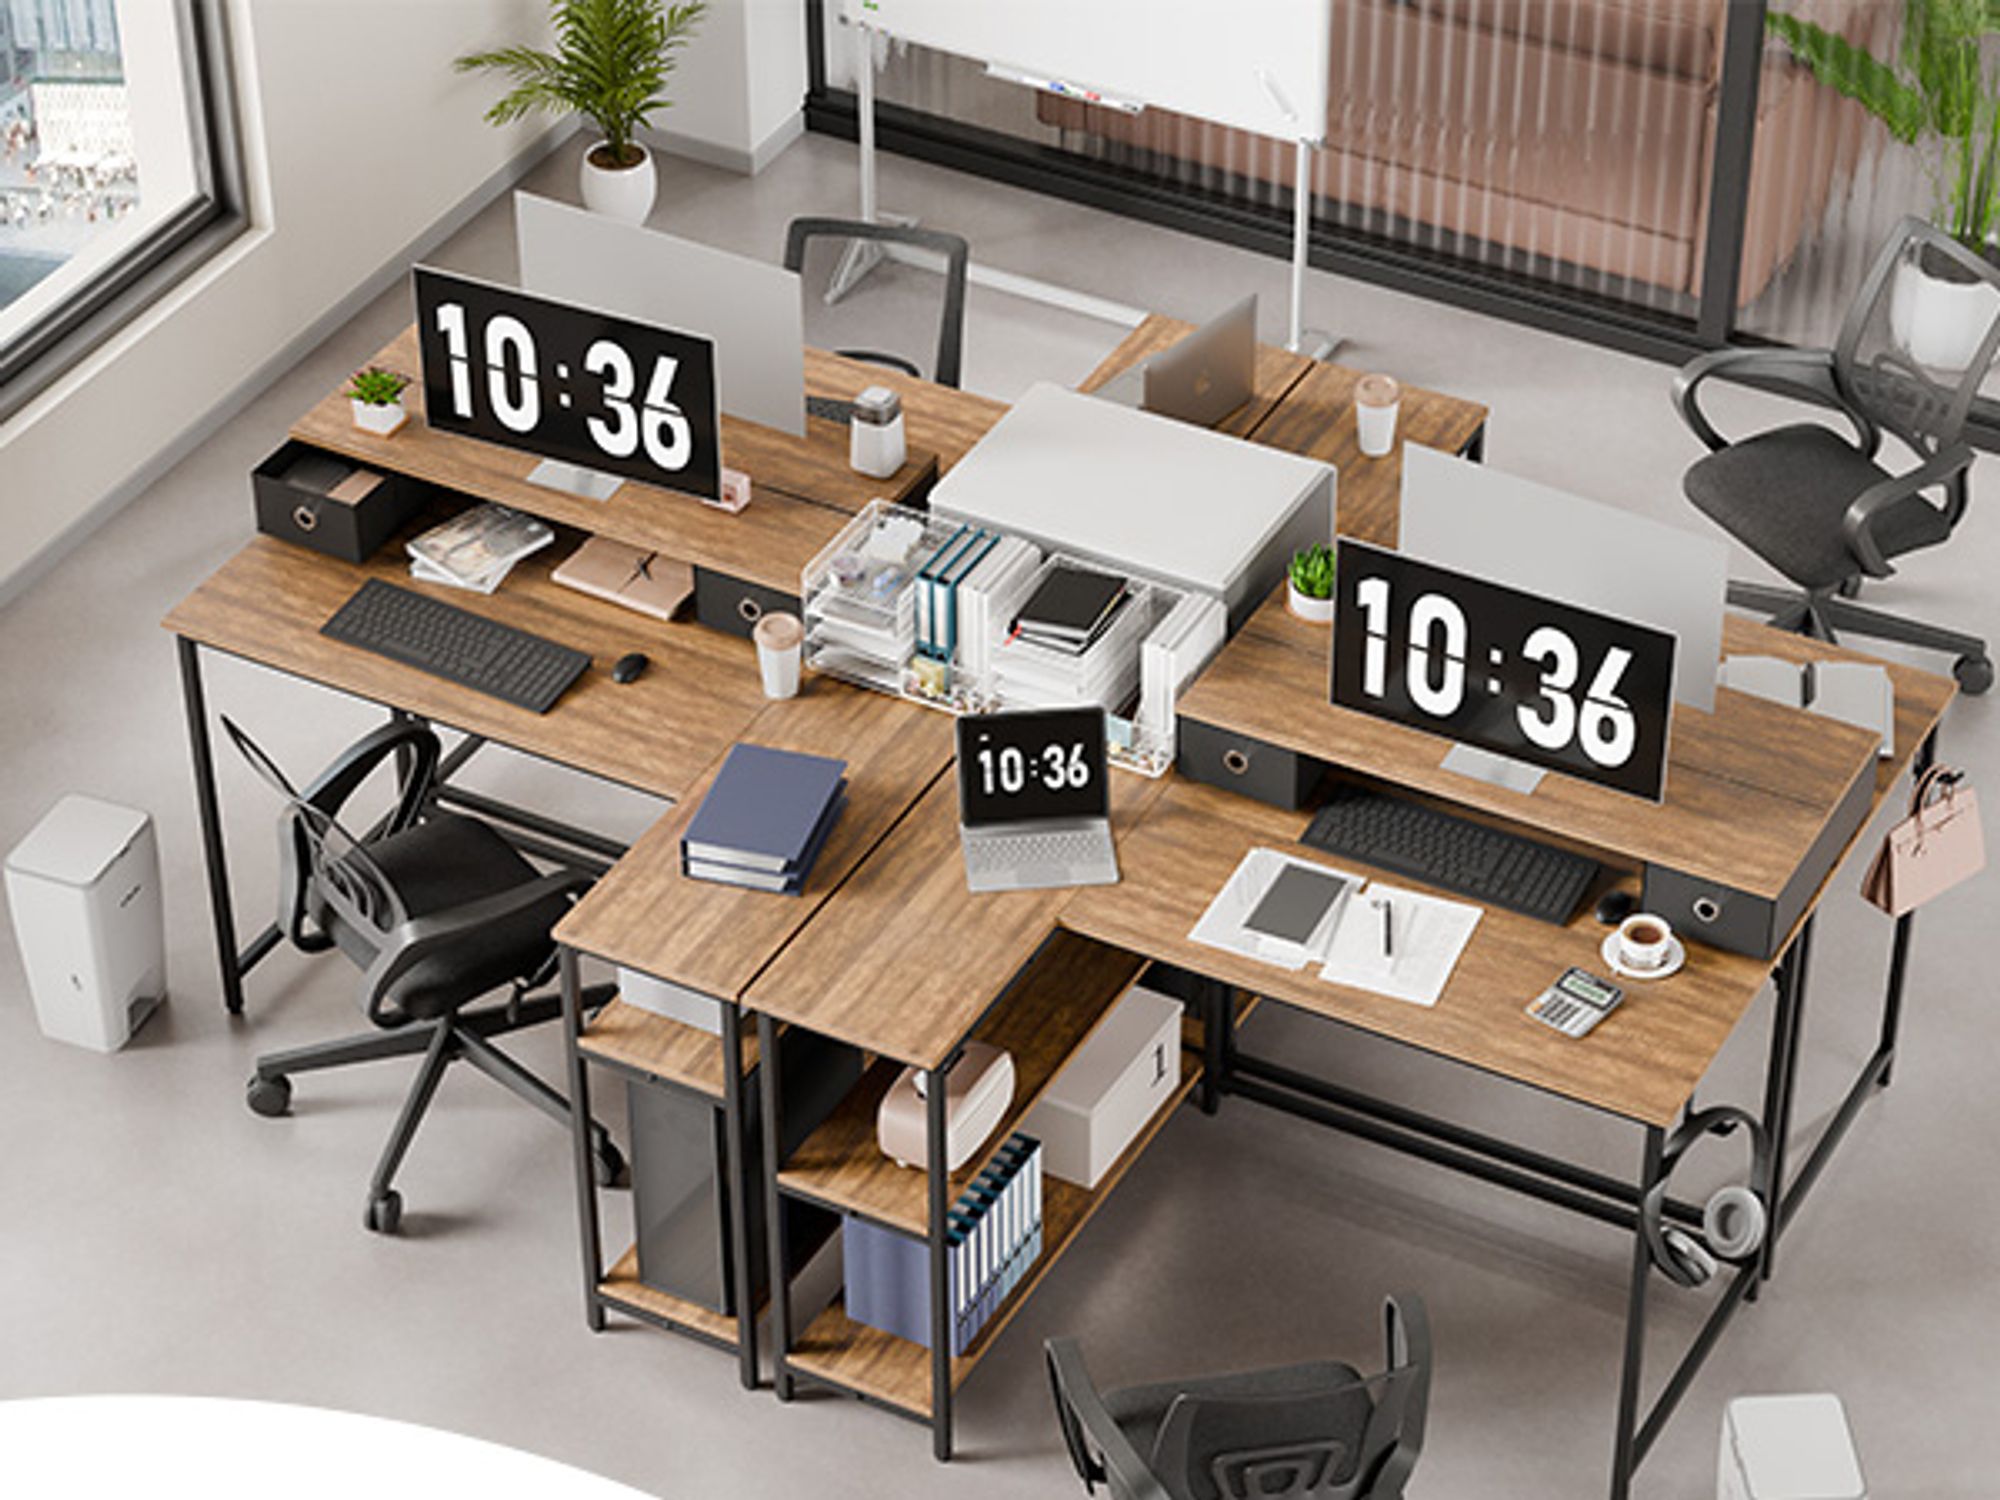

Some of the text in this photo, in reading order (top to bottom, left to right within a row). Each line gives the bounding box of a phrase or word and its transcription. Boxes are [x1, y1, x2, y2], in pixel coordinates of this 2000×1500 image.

[436, 303, 692, 471] 10:36
[1356, 577, 1636, 768] 10:36
[978, 743, 1090, 795] 10:36
[1151, 1043, 1167, 1088] 1
